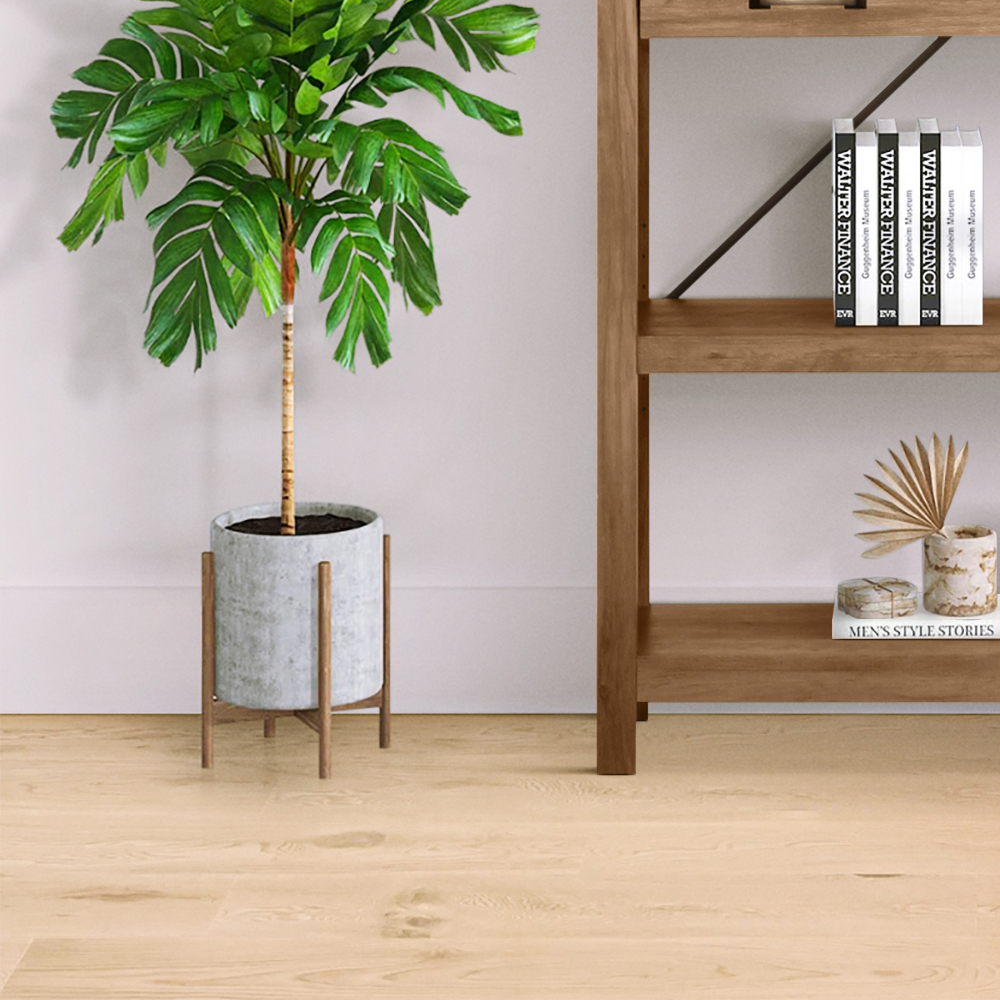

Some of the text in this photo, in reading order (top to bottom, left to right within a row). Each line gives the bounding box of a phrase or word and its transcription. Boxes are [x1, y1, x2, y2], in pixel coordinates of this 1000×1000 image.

[837, 149, 851, 295] WALTER FINANCE
[861, 189, 871, 279] Guggenheim Museum
[880, 149, 894, 295] WALTER FINANCE
[905, 189, 915, 279] Guggenheim Museum
[922, 149, 936, 295] WALTER FINANCE
[947, 189, 957, 279] Guggenheim Museum
[968, 189, 978, 279] Guggenheim Museum
[837, 310, 854, 318] EVR
[880, 310, 897, 318] EVR
[921, 310, 938, 318] EVR
[849, 625, 995, 638] MEN'S STYLE STORIES
